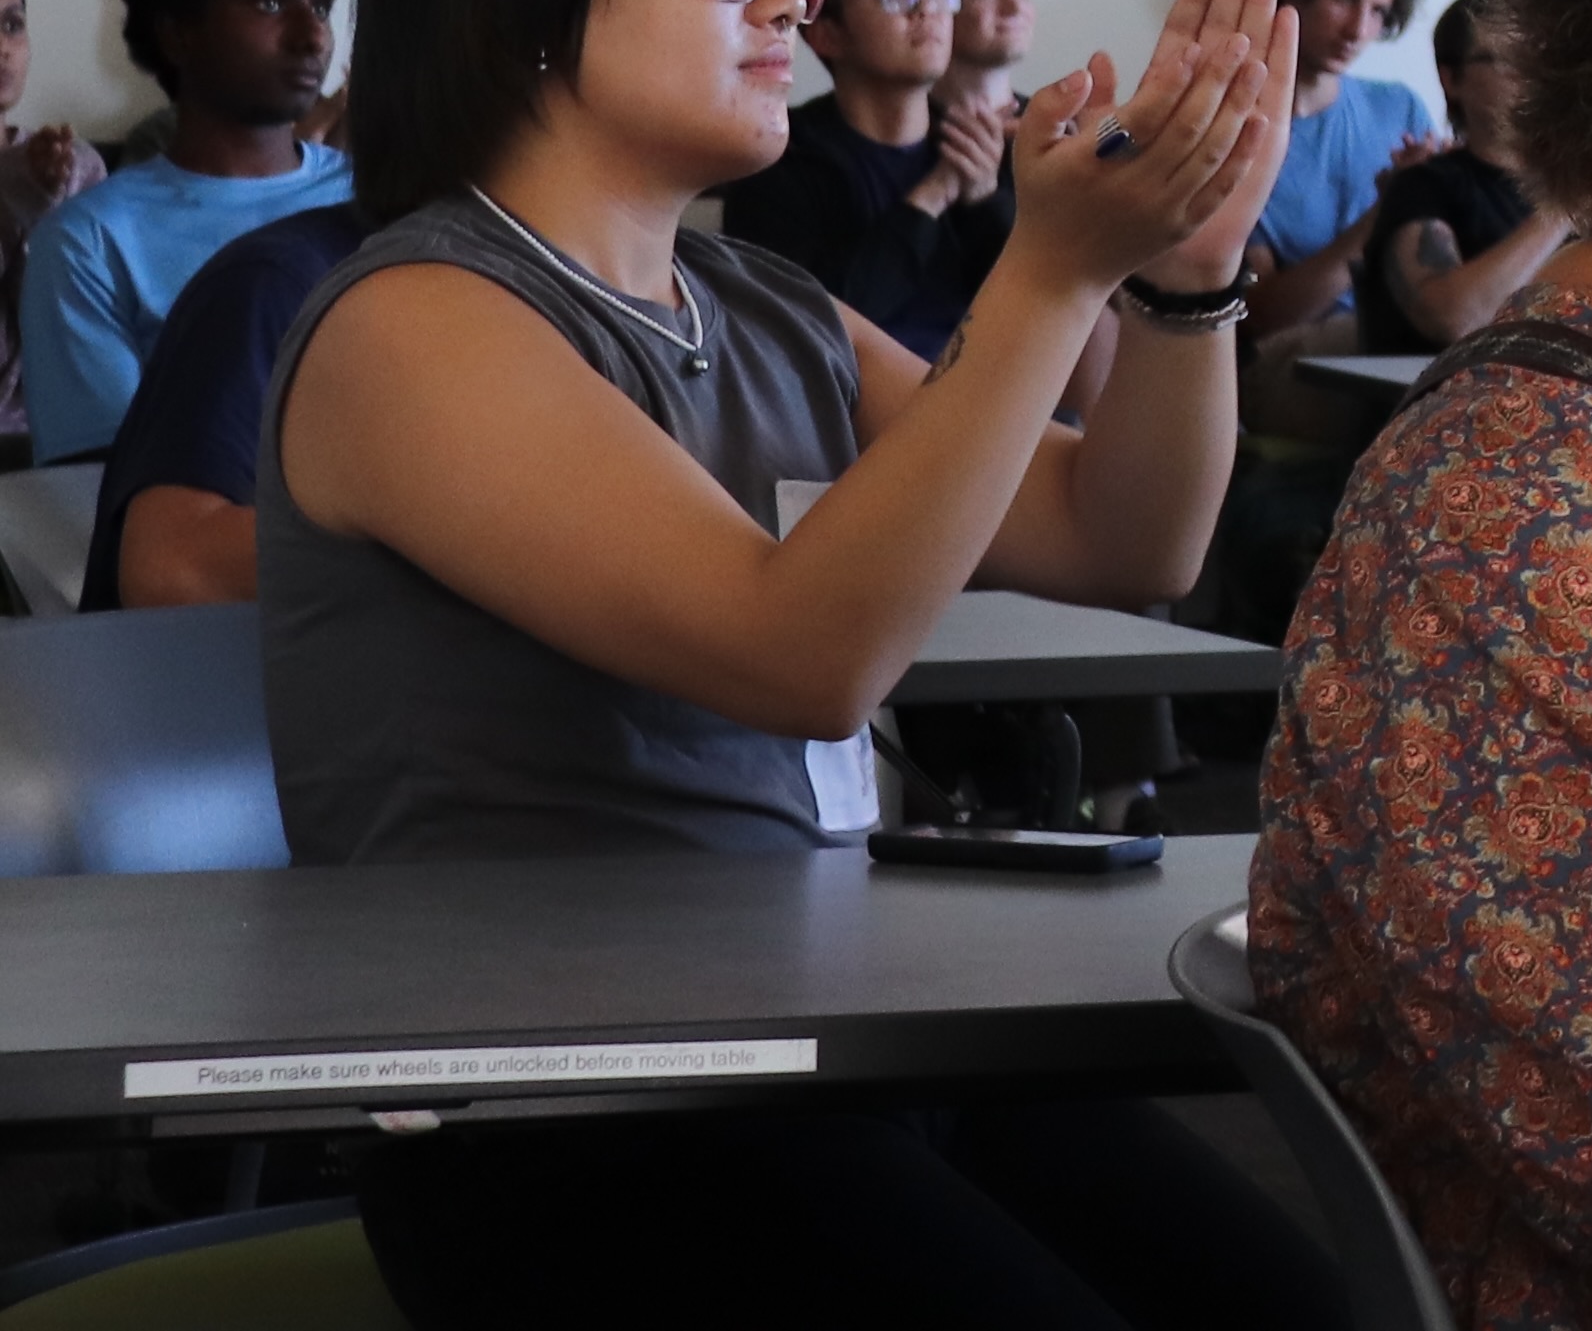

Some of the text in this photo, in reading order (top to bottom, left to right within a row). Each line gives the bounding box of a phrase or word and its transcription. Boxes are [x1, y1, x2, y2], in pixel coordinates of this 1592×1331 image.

[198, 1049, 756, 1085] Please make sure wheels are unlocked before moving table
